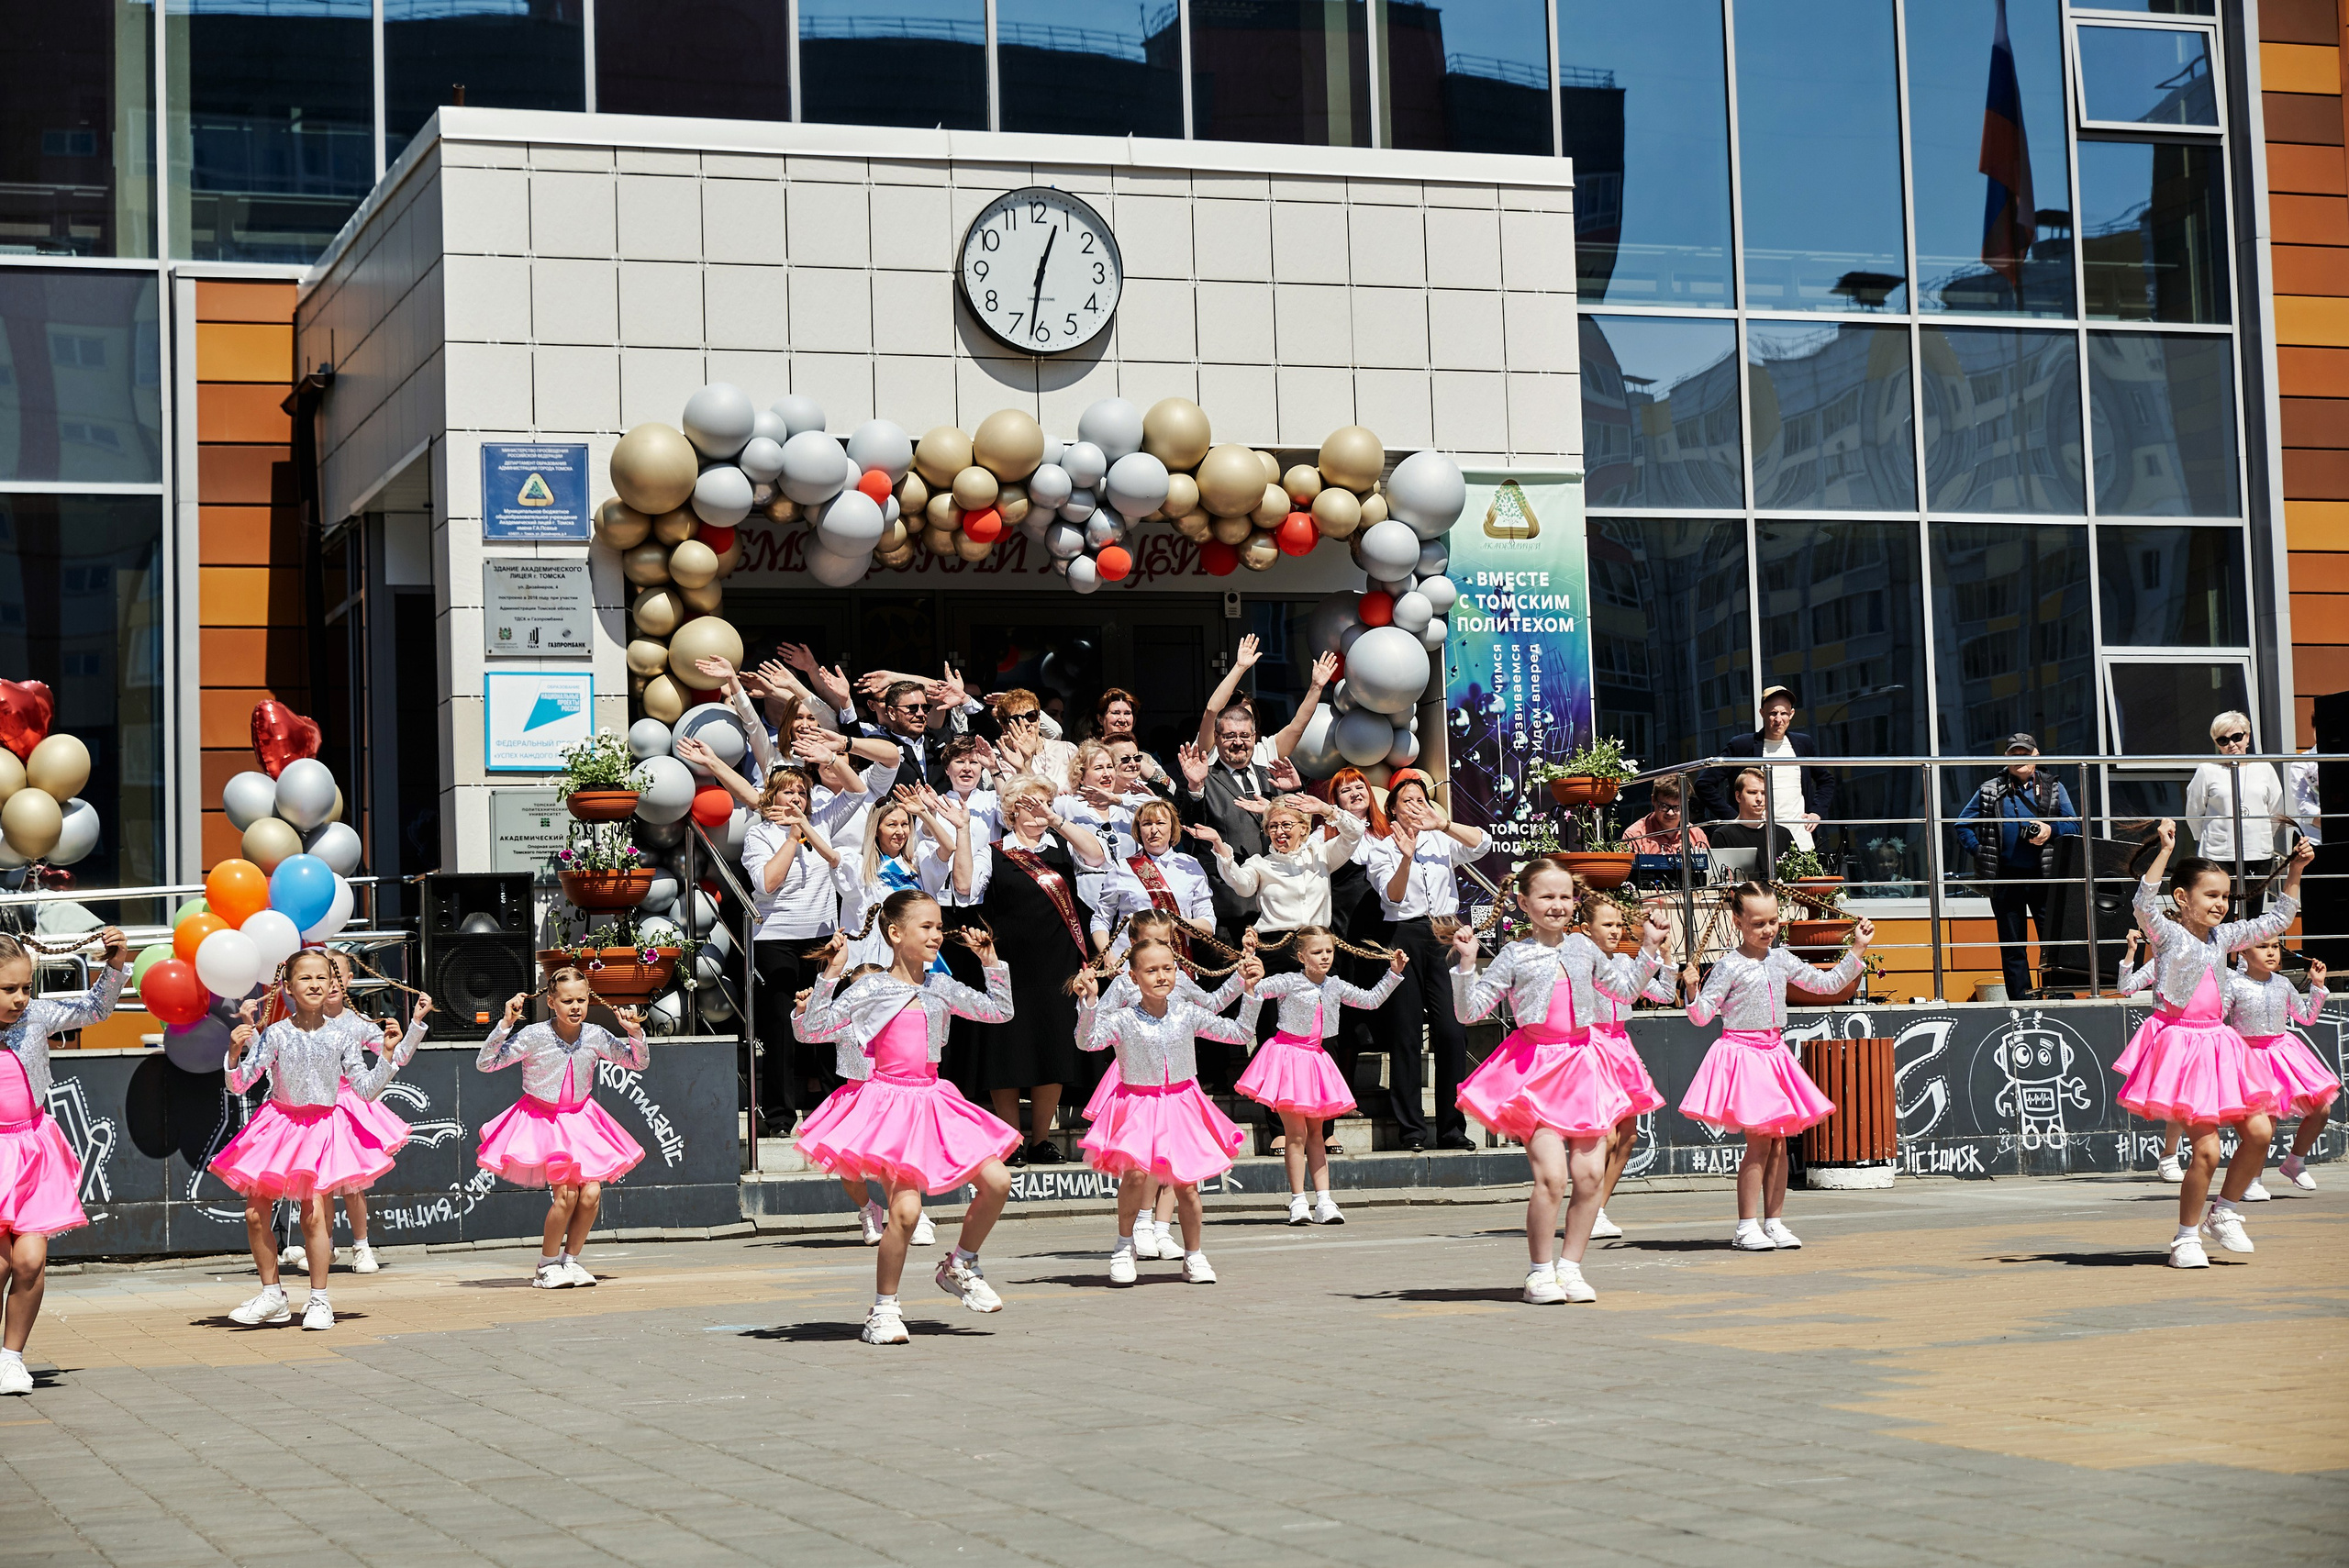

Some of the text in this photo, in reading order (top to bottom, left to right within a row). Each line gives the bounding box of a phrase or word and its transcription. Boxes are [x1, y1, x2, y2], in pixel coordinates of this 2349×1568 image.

[1003, 208, 1017, 230] 11
[1028, 202, 1047, 224] 12
[1063, 210, 1069, 232] 1
[980, 229, 1000, 251] 10
[1081, 232, 1094, 254] 2
[974, 261, 989, 283] 9
[1092, 261, 1105, 284] 3
[985, 290, 998, 312] 8
[1084, 292, 1098, 314] 4
[1008, 313, 1024, 334] 7
[1035, 320, 1051, 342] 6
[1063, 313, 1077, 335] 5
[1476, 572, 1550, 586] ВМЕСТЕ
[1459, 595, 1570, 609] С ТОМСКИМ
[1457, 617, 1575, 632] ПОЛИТЕХОМ
[1493, 644, 1504, 704] Учимся
[1511, 644, 1524, 750] Развиваемся
[1530, 643, 1543, 751] Идем вперед
